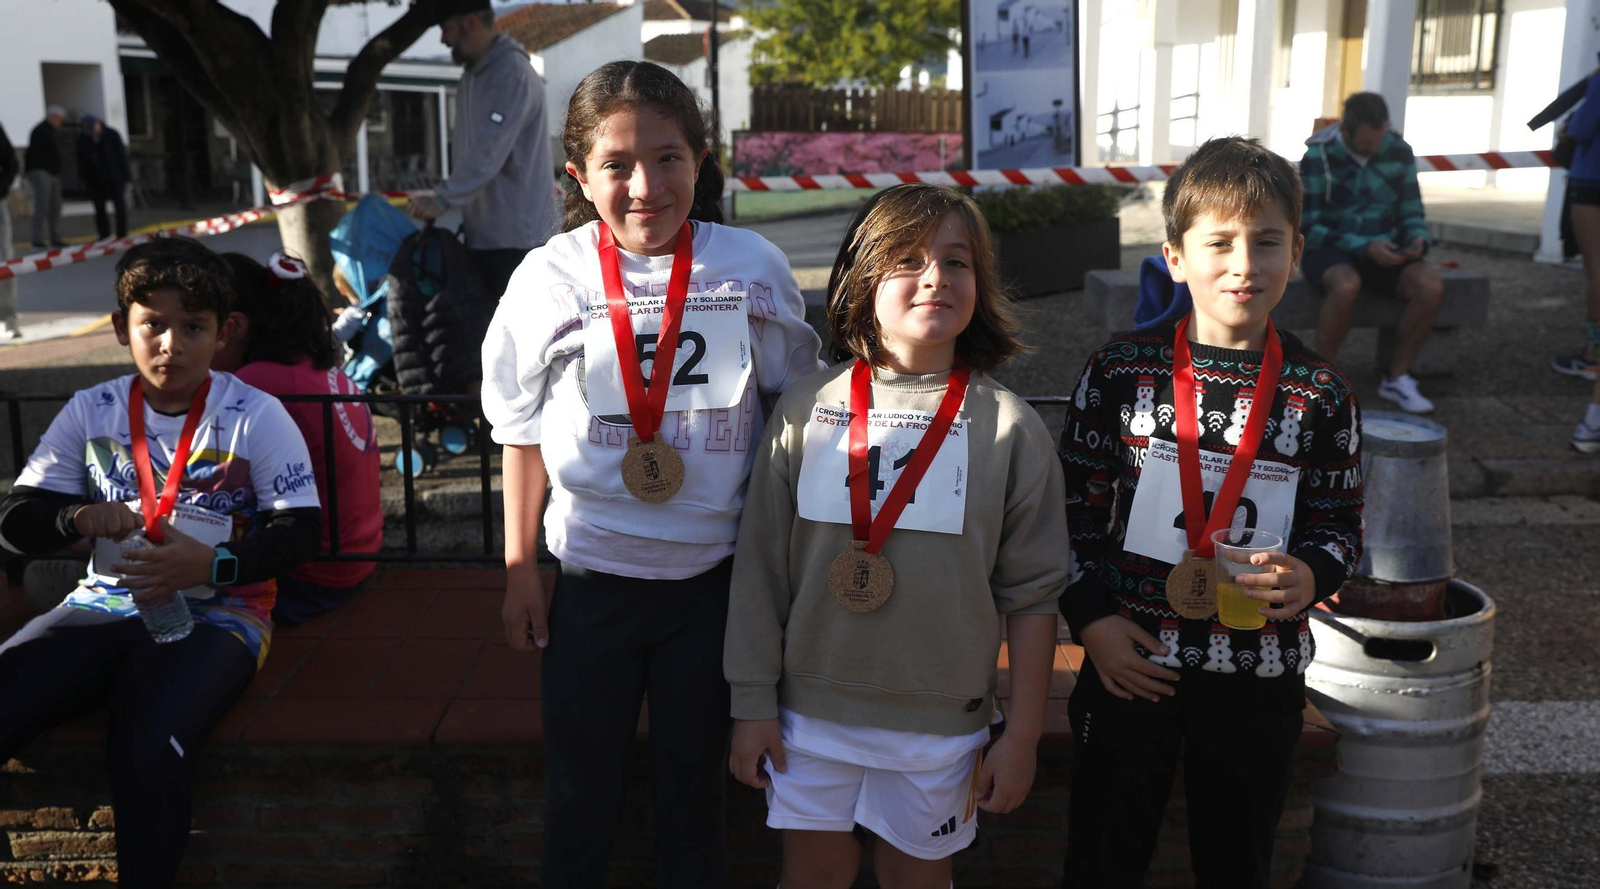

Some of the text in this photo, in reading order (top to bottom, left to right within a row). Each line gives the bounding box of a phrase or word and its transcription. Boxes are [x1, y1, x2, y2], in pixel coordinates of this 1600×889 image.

[590, 306, 652, 320] CASLAR
[684, 303, 740, 313] FRONTERA
[626, 299, 660, 308] OPULAR
[693, 296, 699, 304] Y
[699, 295, 743, 304] SOLIDARIO
[635, 330, 709, 389] 52
[816, 415, 960, 437] CASTER DE LA FRORA
[818, 407, 845, 419] CROSS
[914, 414, 922, 422] Y
[922, 415, 964, 430] SORIO
[1073, 421, 1120, 456] LOA
[1151, 451, 1211, 472] CASTAR
[1213, 463, 1229, 475] DE
[1248, 471, 1290, 484] FRONTERA
[1309, 462, 1362, 490] STM
[182, 513, 227, 527] FRONTERA
